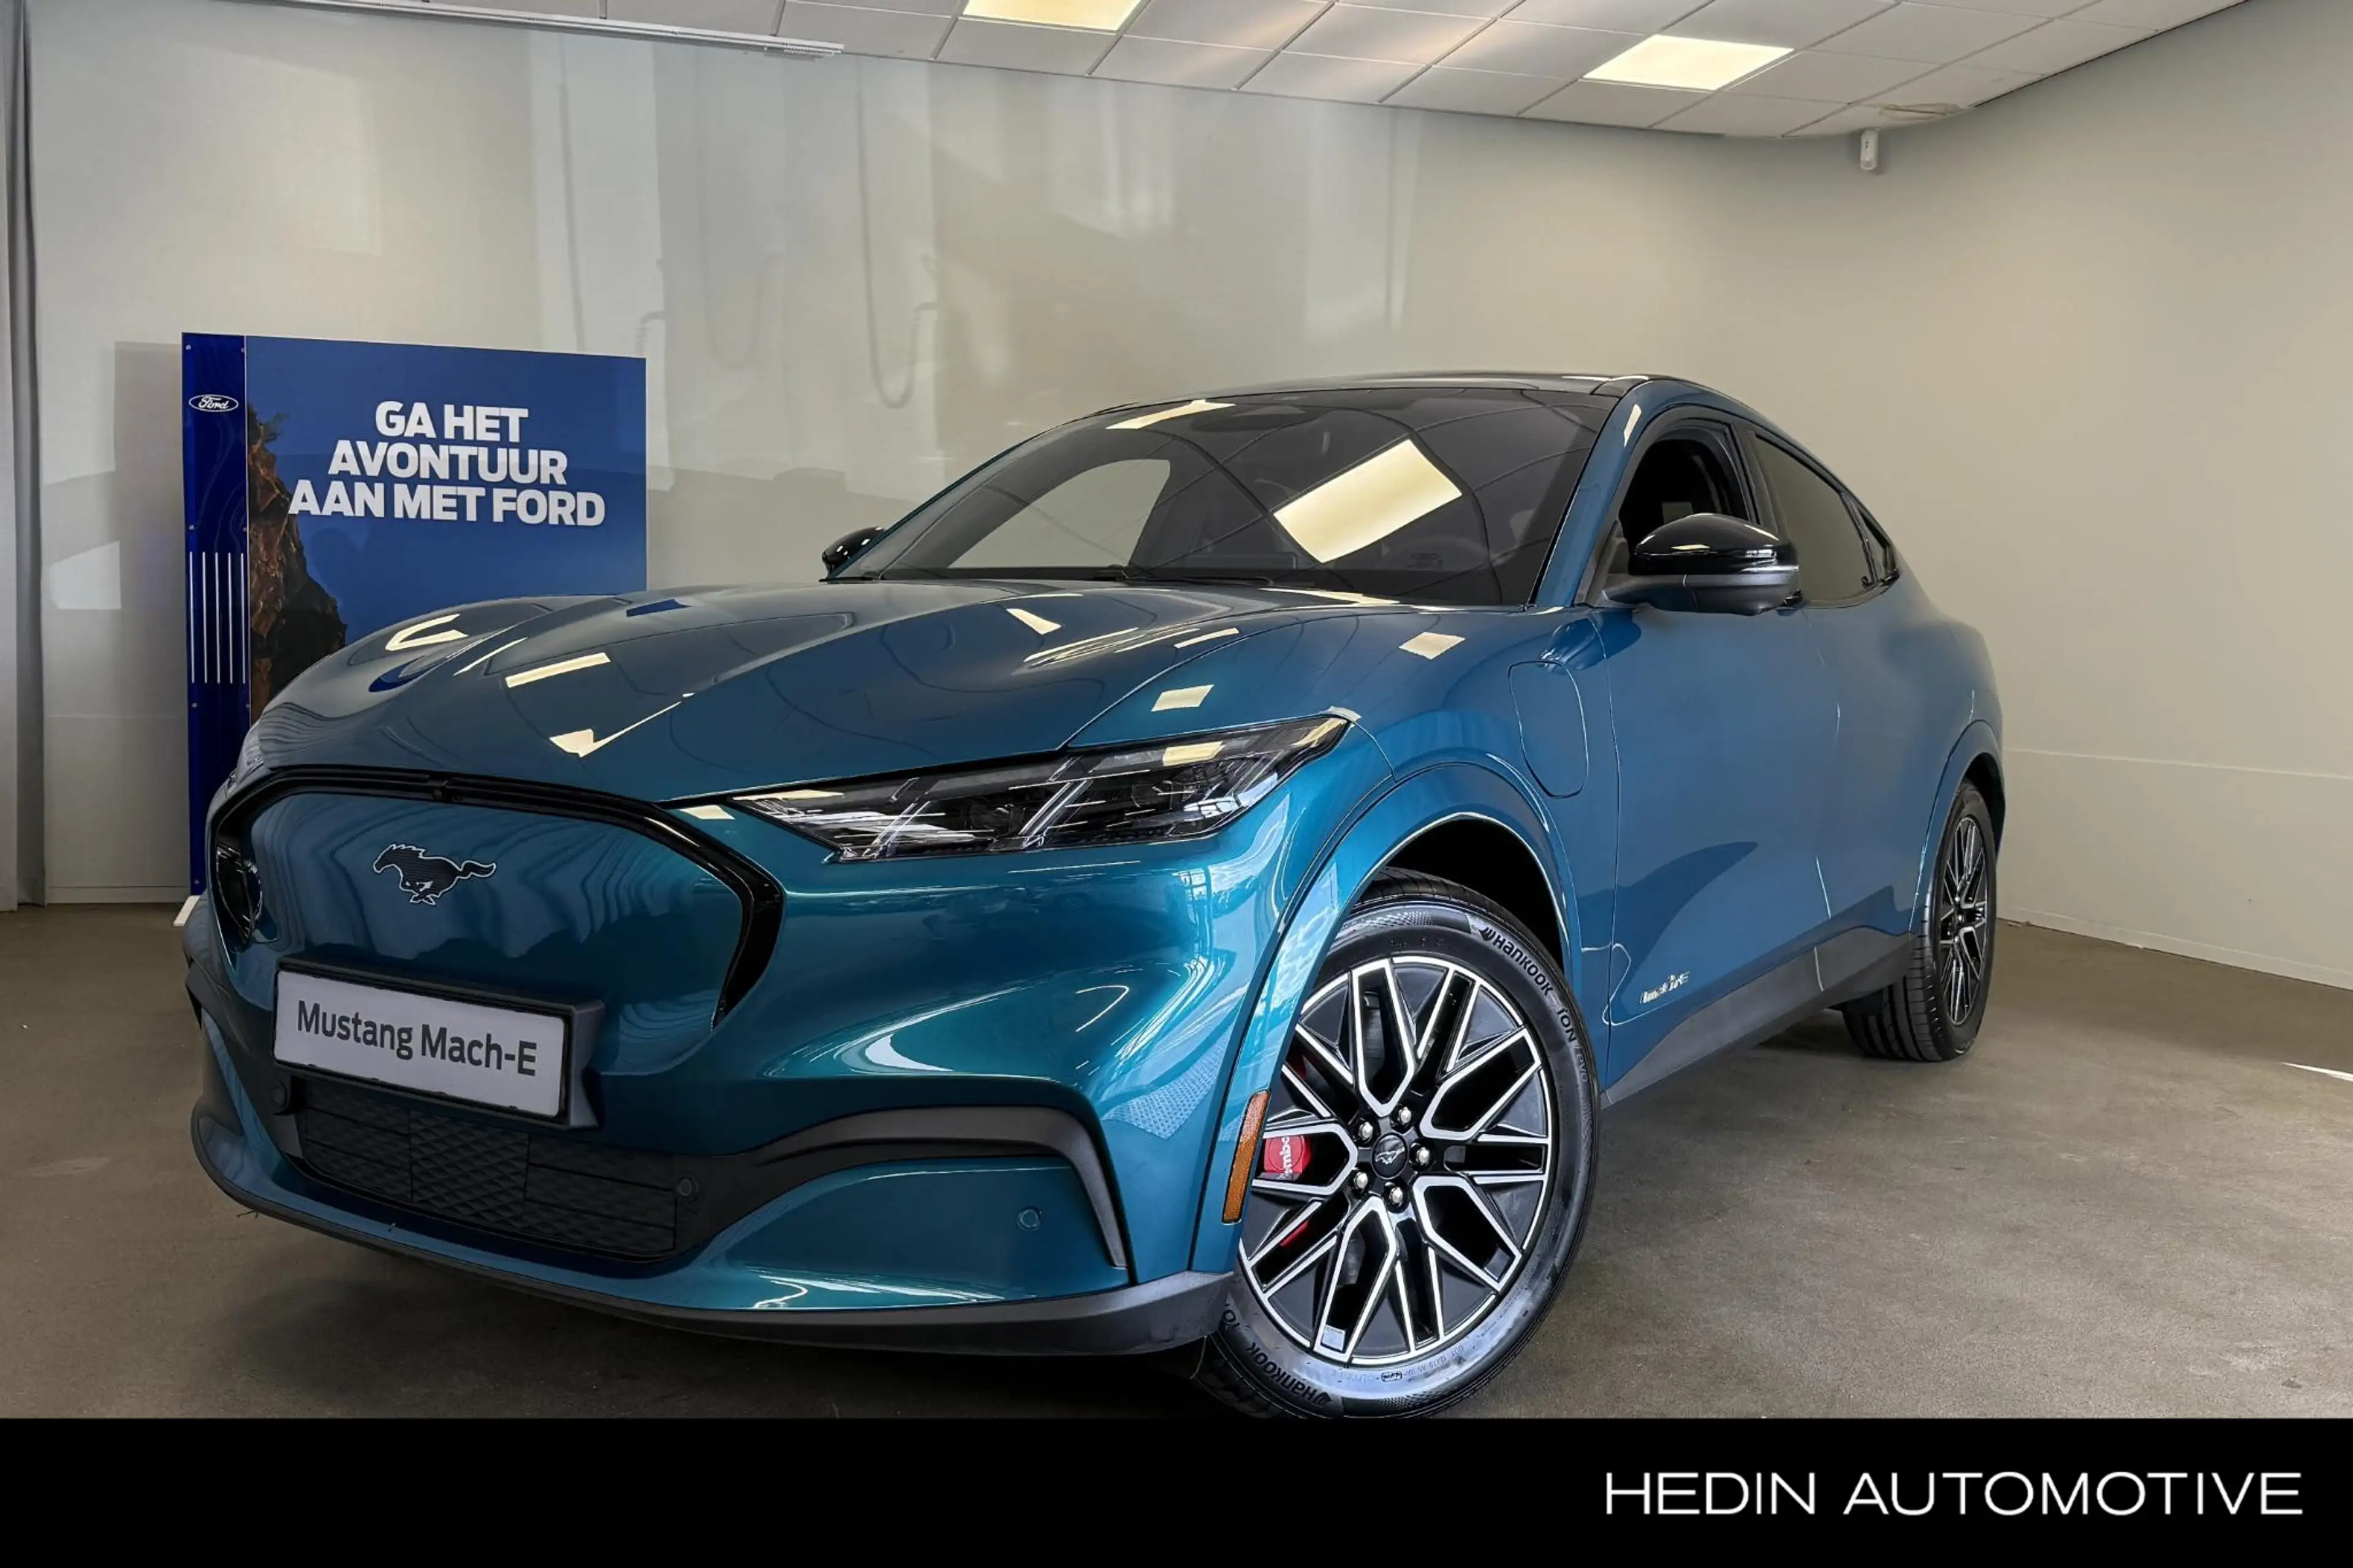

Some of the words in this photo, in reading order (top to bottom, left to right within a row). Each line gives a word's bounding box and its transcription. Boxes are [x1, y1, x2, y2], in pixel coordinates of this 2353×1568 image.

[198, 395, 229, 409] Ford
[376, 401, 436, 439] GA
[444, 404, 529, 442] HET
[328, 440, 567, 485] AVONTUUR
[288, 479, 384, 518] AAN
[393, 483, 486, 522] MET
[493, 488, 605, 526] FORD
[297, 1001, 413, 1060] Mustang
[421, 1024, 537, 1077] Mach-E
